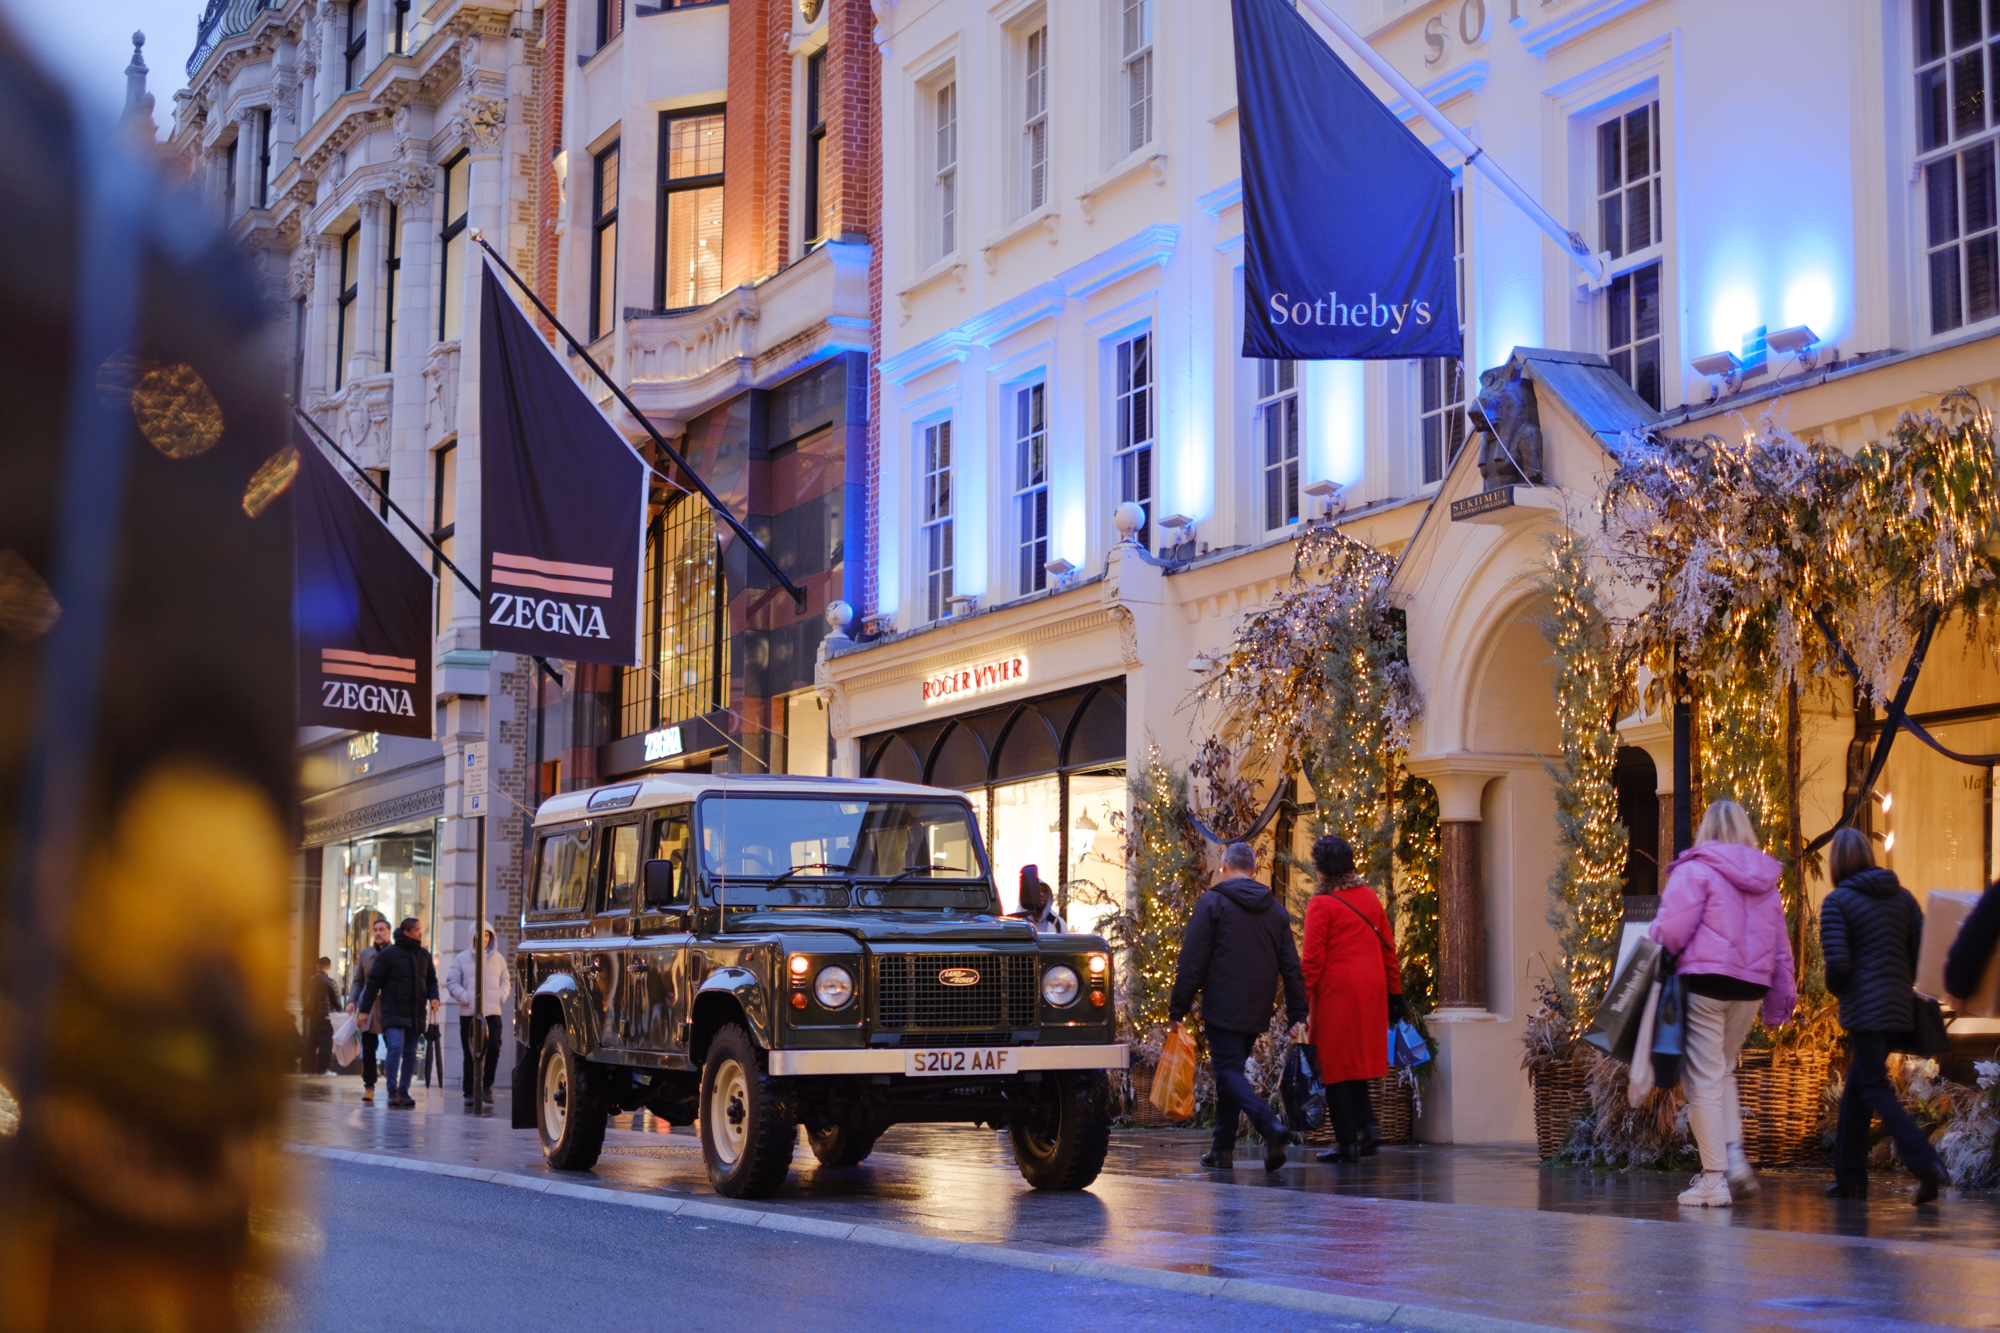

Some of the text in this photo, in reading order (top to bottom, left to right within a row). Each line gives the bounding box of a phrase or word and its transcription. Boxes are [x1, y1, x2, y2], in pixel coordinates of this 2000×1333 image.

[1270, 291, 1432, 335] Sotheby's
[489, 592, 610, 639] ZEGNA
[923, 659, 1023, 700] ROGER VIVIER
[321, 681, 416, 717] ZEGNA
[1960, 775, 2000, 791] Mae
[914, 1050, 1009, 1072] S202 AAF
